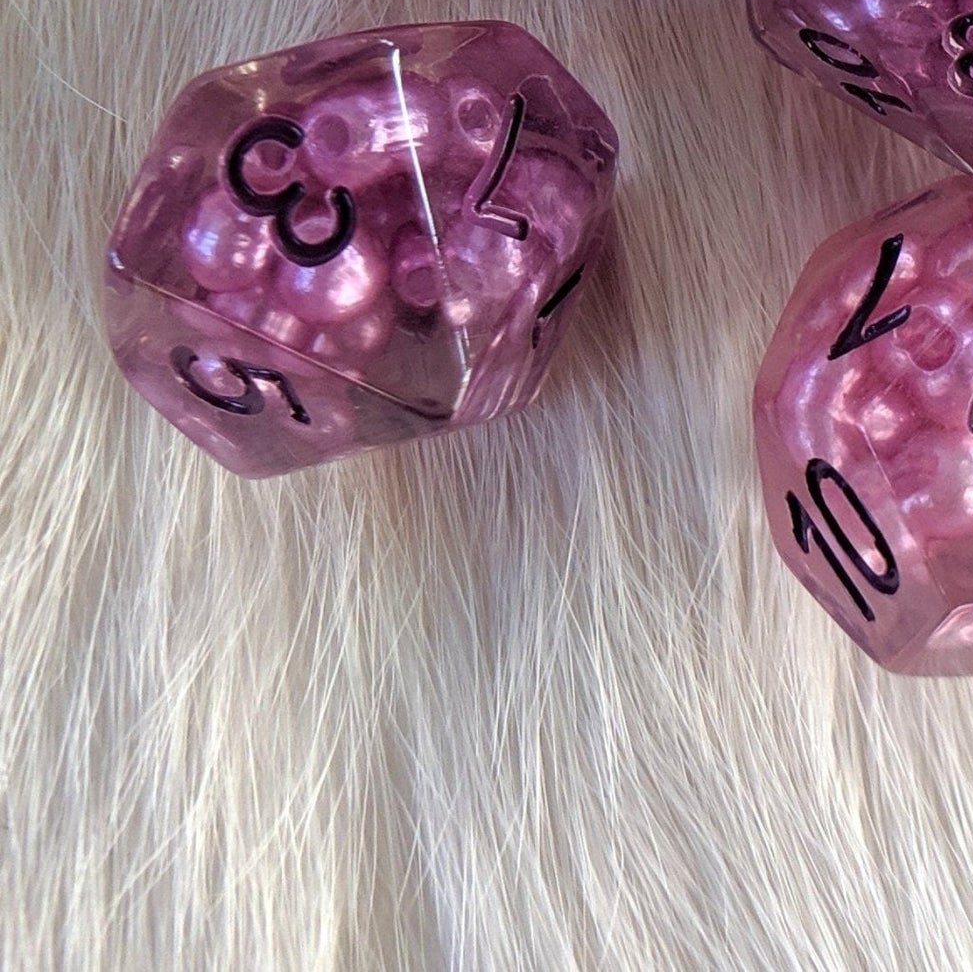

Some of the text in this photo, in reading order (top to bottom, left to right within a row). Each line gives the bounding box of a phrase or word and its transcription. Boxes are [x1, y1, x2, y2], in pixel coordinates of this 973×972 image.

[219, 115, 358, 268] 3
[170, 345, 312, 426] 5
[785, 458, 900, 623] 10
